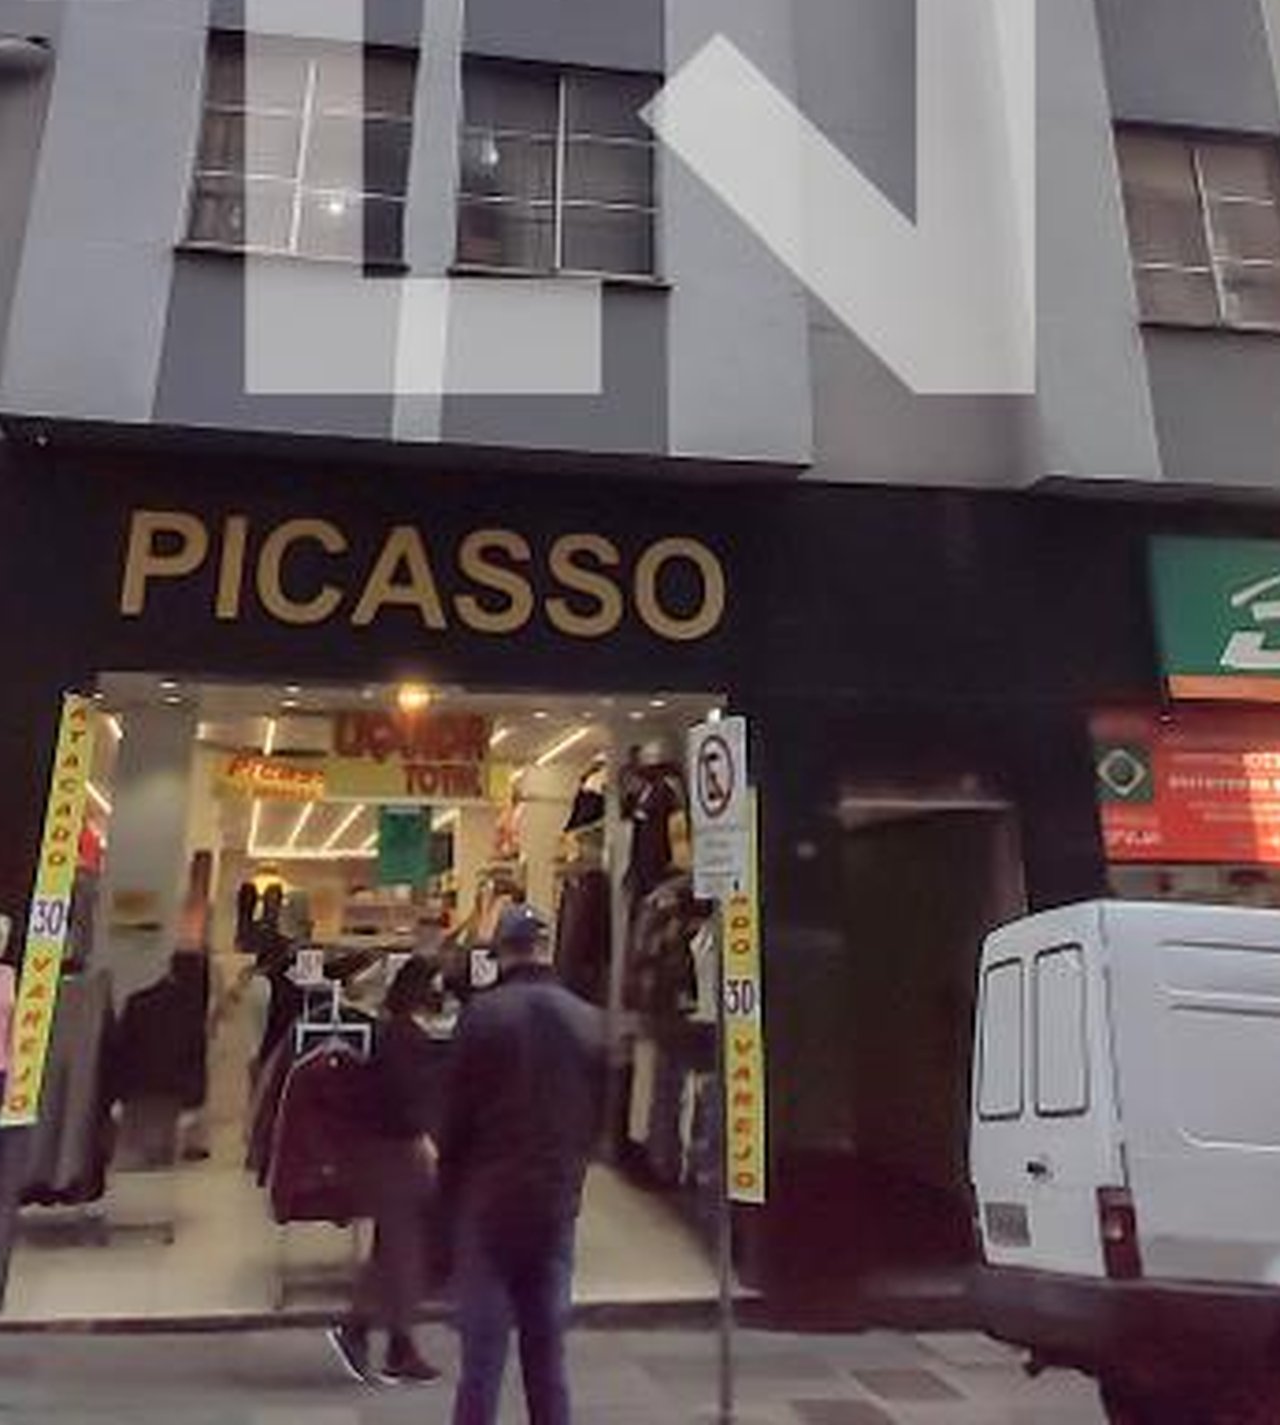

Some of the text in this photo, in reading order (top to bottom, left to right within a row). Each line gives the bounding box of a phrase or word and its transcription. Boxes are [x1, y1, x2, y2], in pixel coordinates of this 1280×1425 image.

[120, 508, 727, 643] PICASSO
[33, 900, 64, 935] 30
[725, 978, 754, 1015] 30
